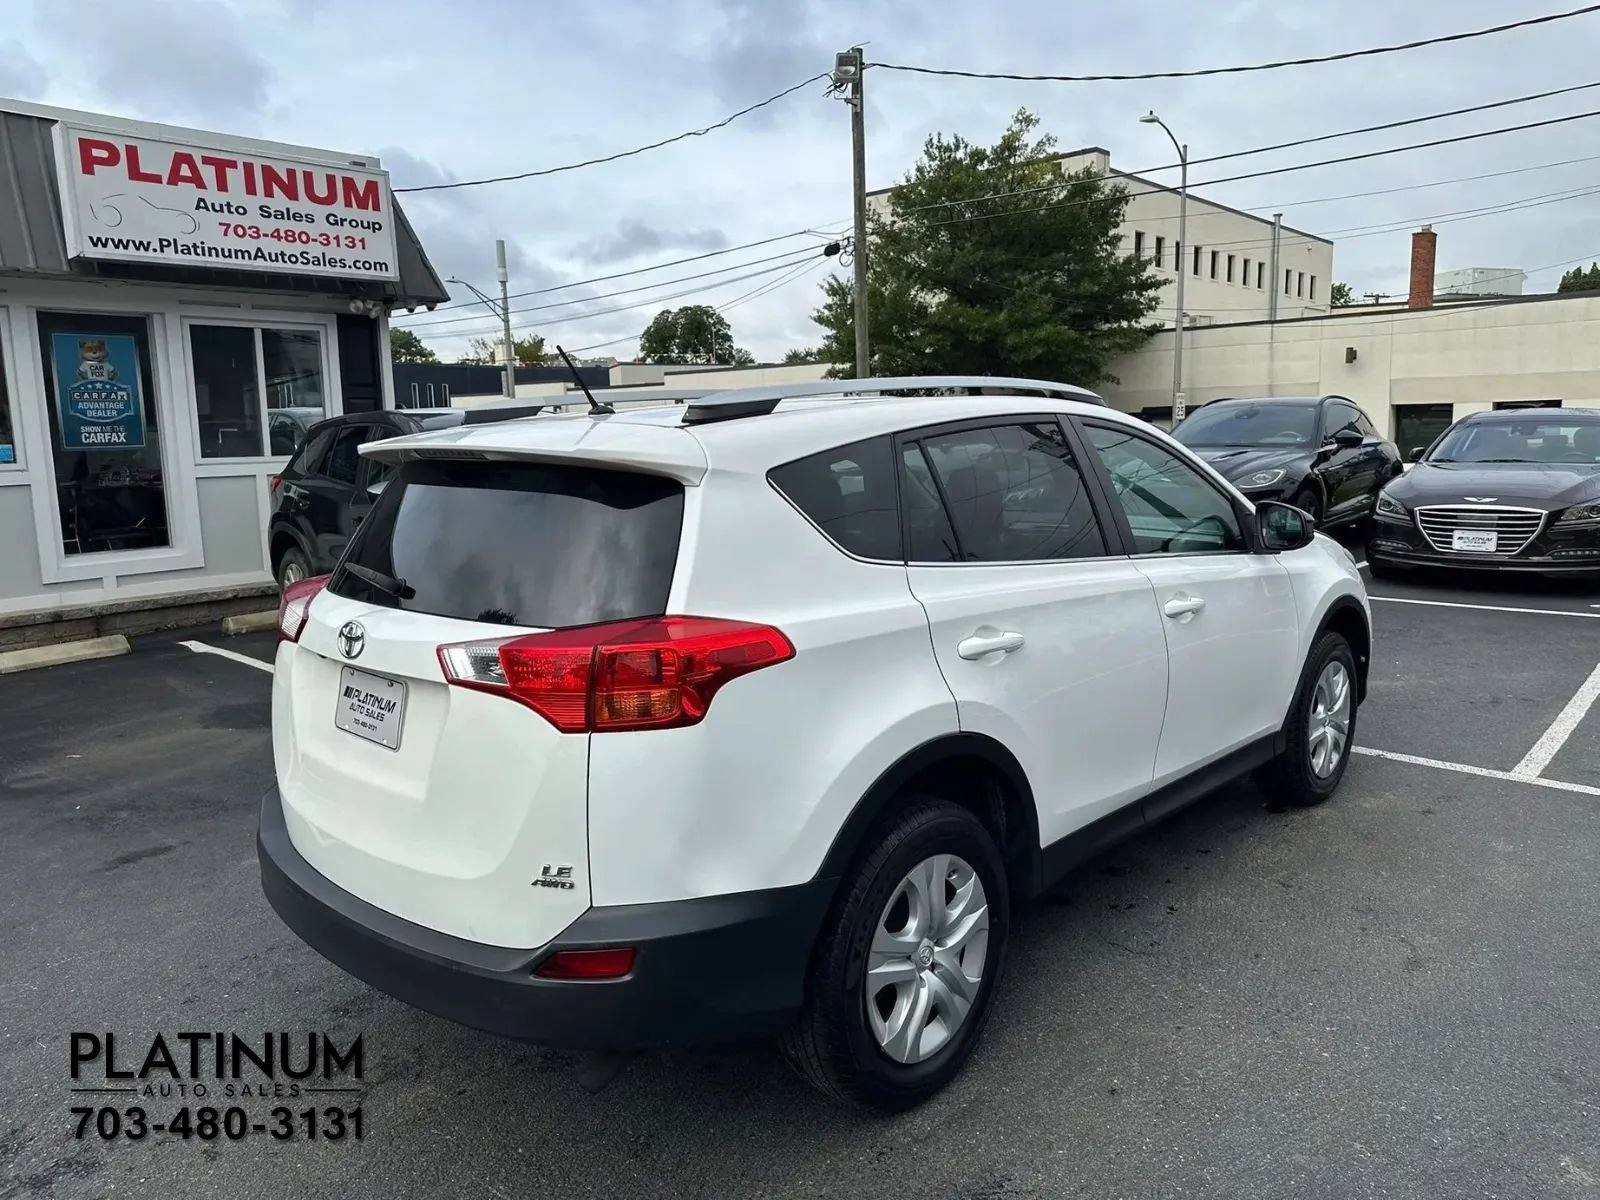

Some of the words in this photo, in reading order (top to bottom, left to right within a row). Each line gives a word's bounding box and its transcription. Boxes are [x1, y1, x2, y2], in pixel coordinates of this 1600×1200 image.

[78, 138, 381, 212] PLATINUM
[195, 197, 248, 216] Auto
[258, 204, 315, 224] Sales
[325, 212, 383, 233] Group
[218, 222, 367, 250] 703-480-3131
[88, 235, 389, 272] www.PlatinumAutoSales.com
[73, 391, 127, 400] CARFAX
[87, 409, 118, 417] DEALER
[81, 432, 127, 443] CARFAX
[352, 688, 397, 714] PLATINUM
[349, 702, 365, 715] AUTO
[365, 708, 385, 722] SALES
[541, 863, 573, 878] LE
[530, 878, 575, 889] AWD
